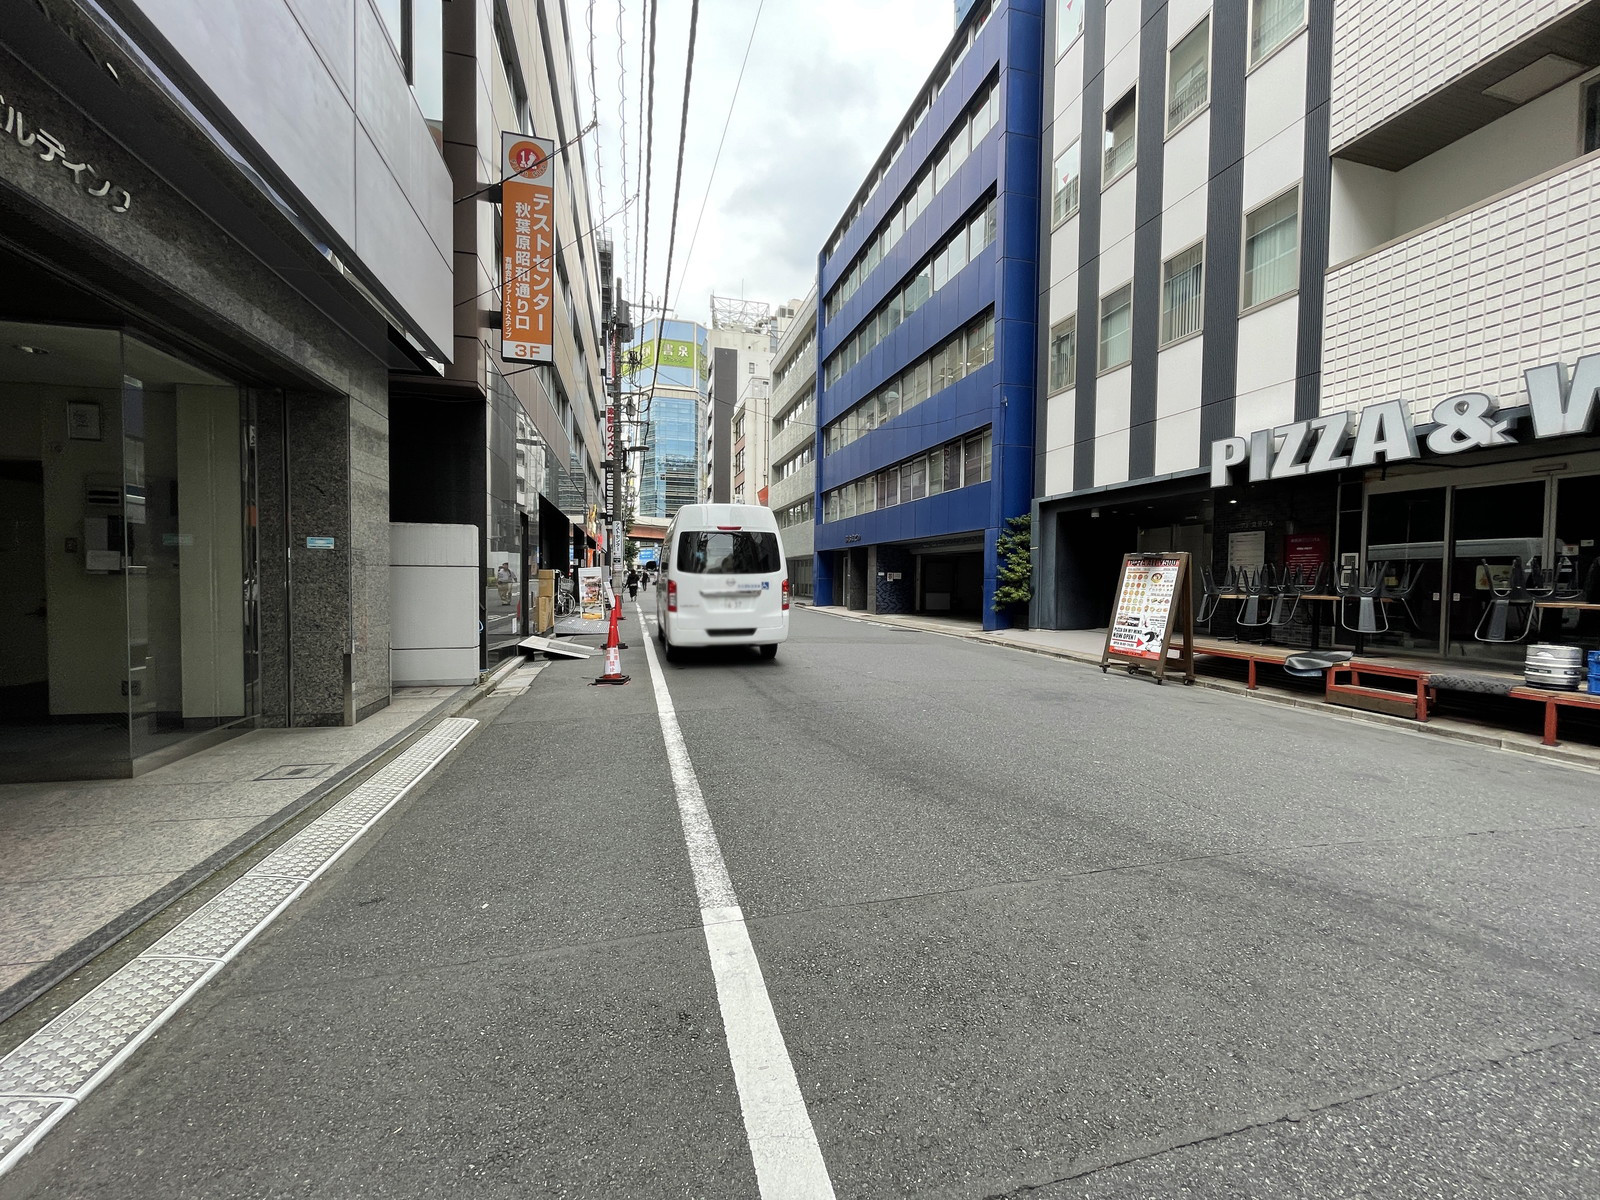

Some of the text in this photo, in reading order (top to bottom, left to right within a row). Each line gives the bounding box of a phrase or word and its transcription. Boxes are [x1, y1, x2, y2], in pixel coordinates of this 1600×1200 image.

[515, 202, 531, 330] 秋葉原昭和通り口
[532, 193, 550, 332] テストセンター
[514, 344, 540, 358] 3F
[1210, 399, 1420, 488] PIZZA
[1426, 392, 1519, 456] &
